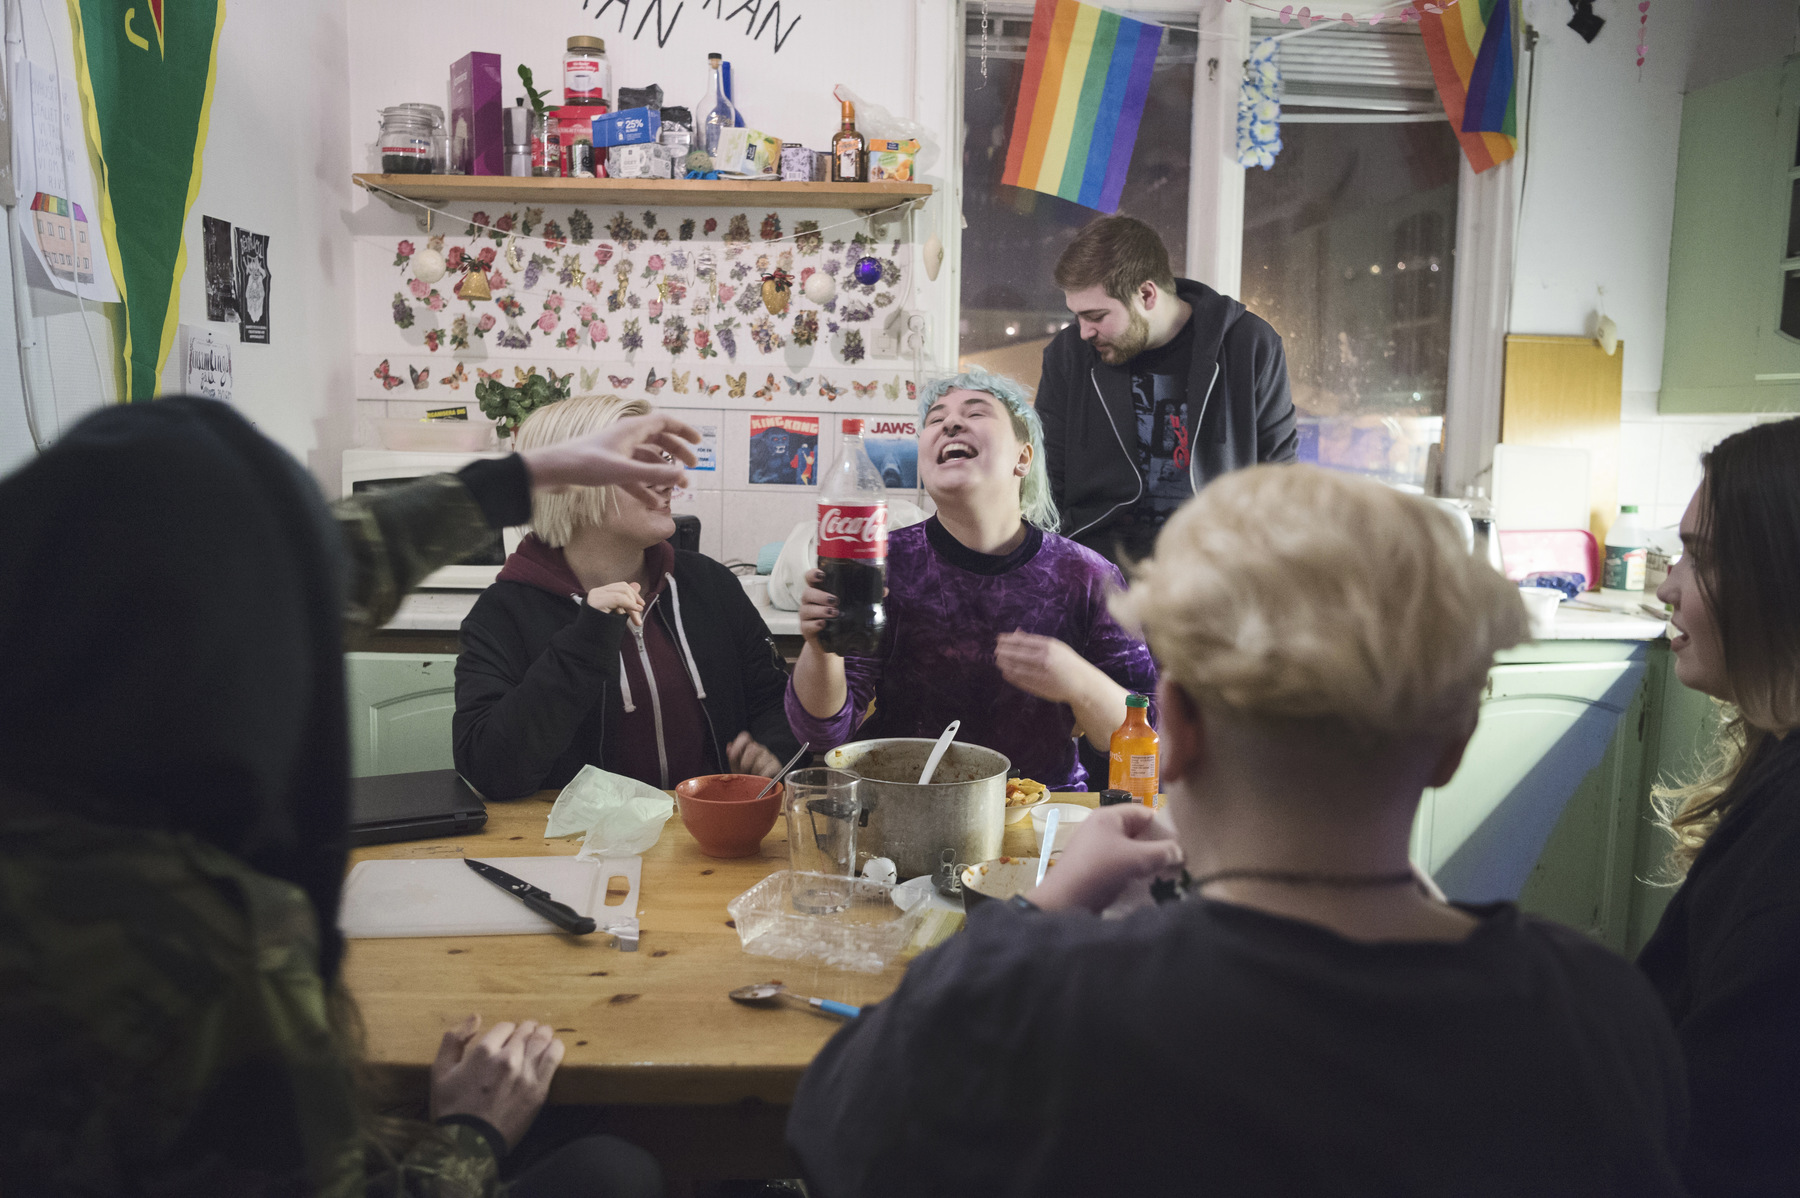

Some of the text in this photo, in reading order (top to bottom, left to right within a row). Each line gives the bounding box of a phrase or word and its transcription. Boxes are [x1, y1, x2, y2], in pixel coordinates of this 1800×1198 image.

[625, 118, 644, 130] 25%
[751, 415, 819, 434] KING KONG
[870, 421, 916, 435] JAWS
